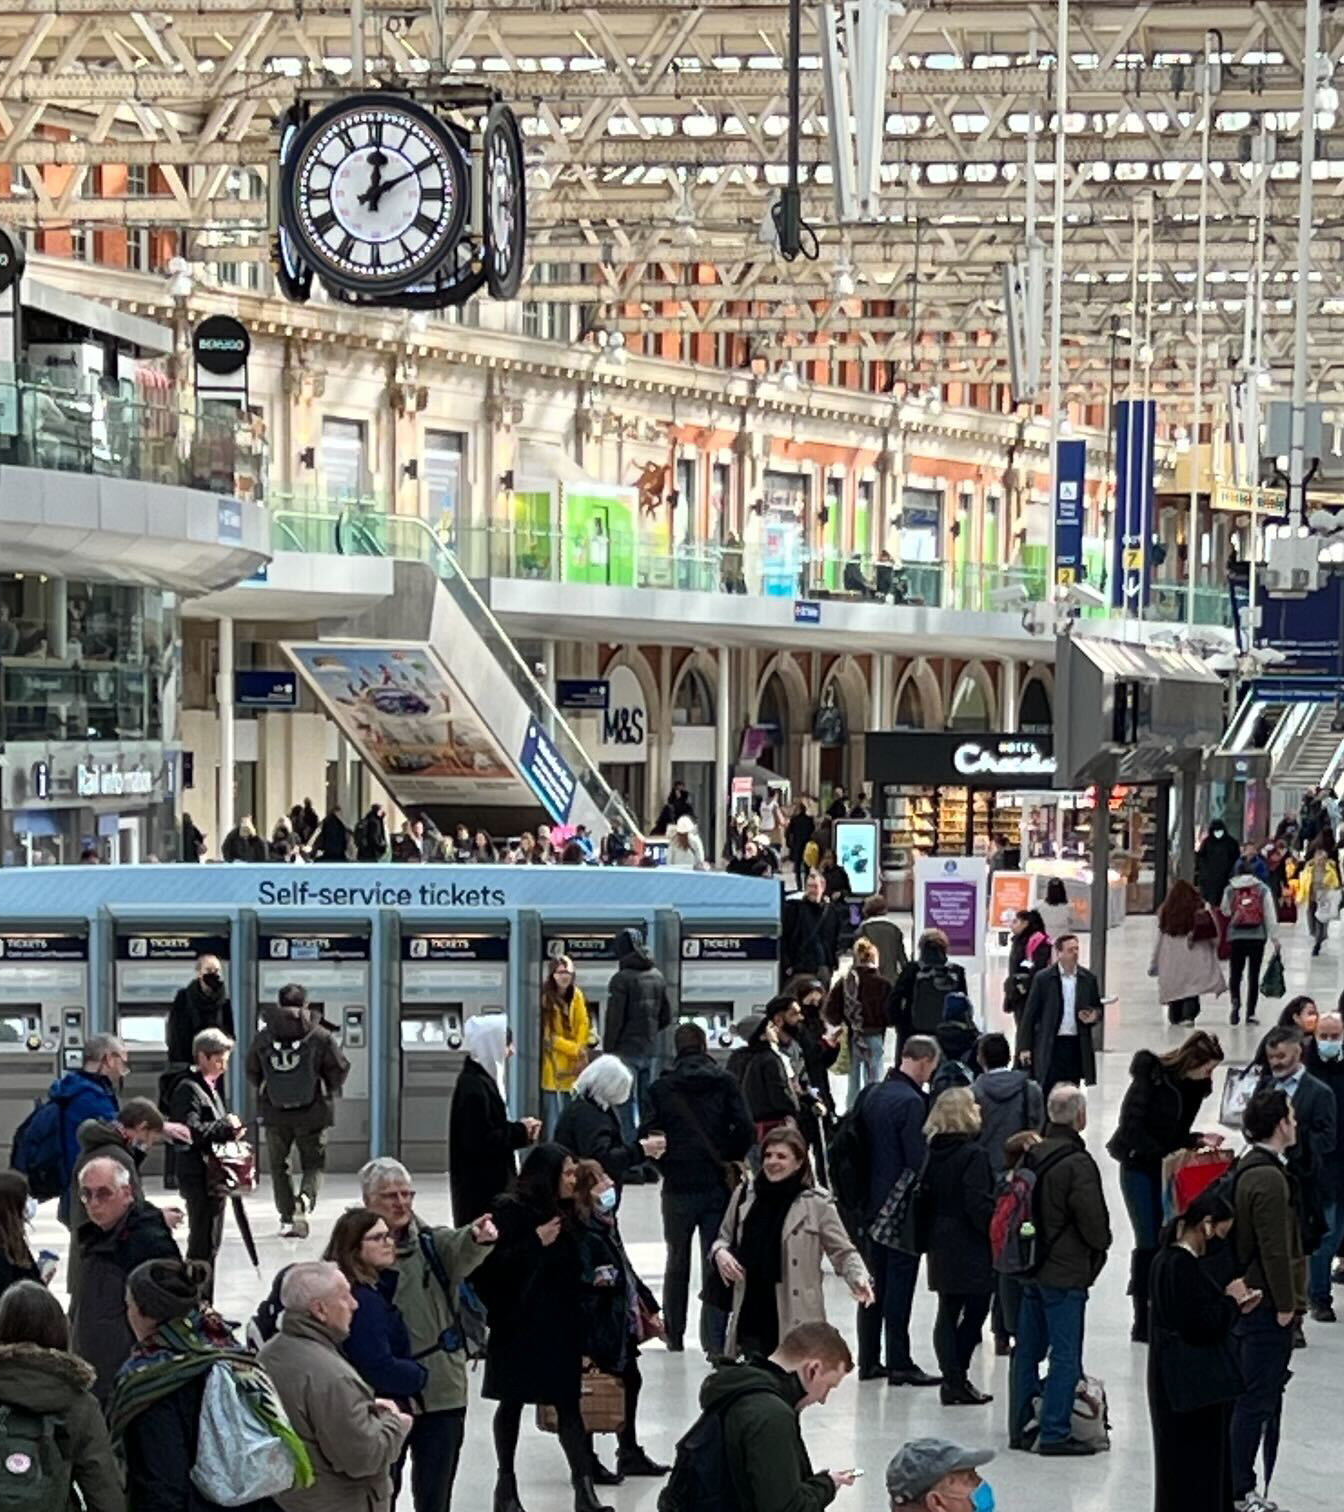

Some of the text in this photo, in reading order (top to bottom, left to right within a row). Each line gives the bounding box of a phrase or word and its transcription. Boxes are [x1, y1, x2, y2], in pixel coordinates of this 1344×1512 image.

[1127, 552, 1137, 567] 7
[603, 707, 644, 745] M&S
[258, 880, 506, 906] Self-service tickets
